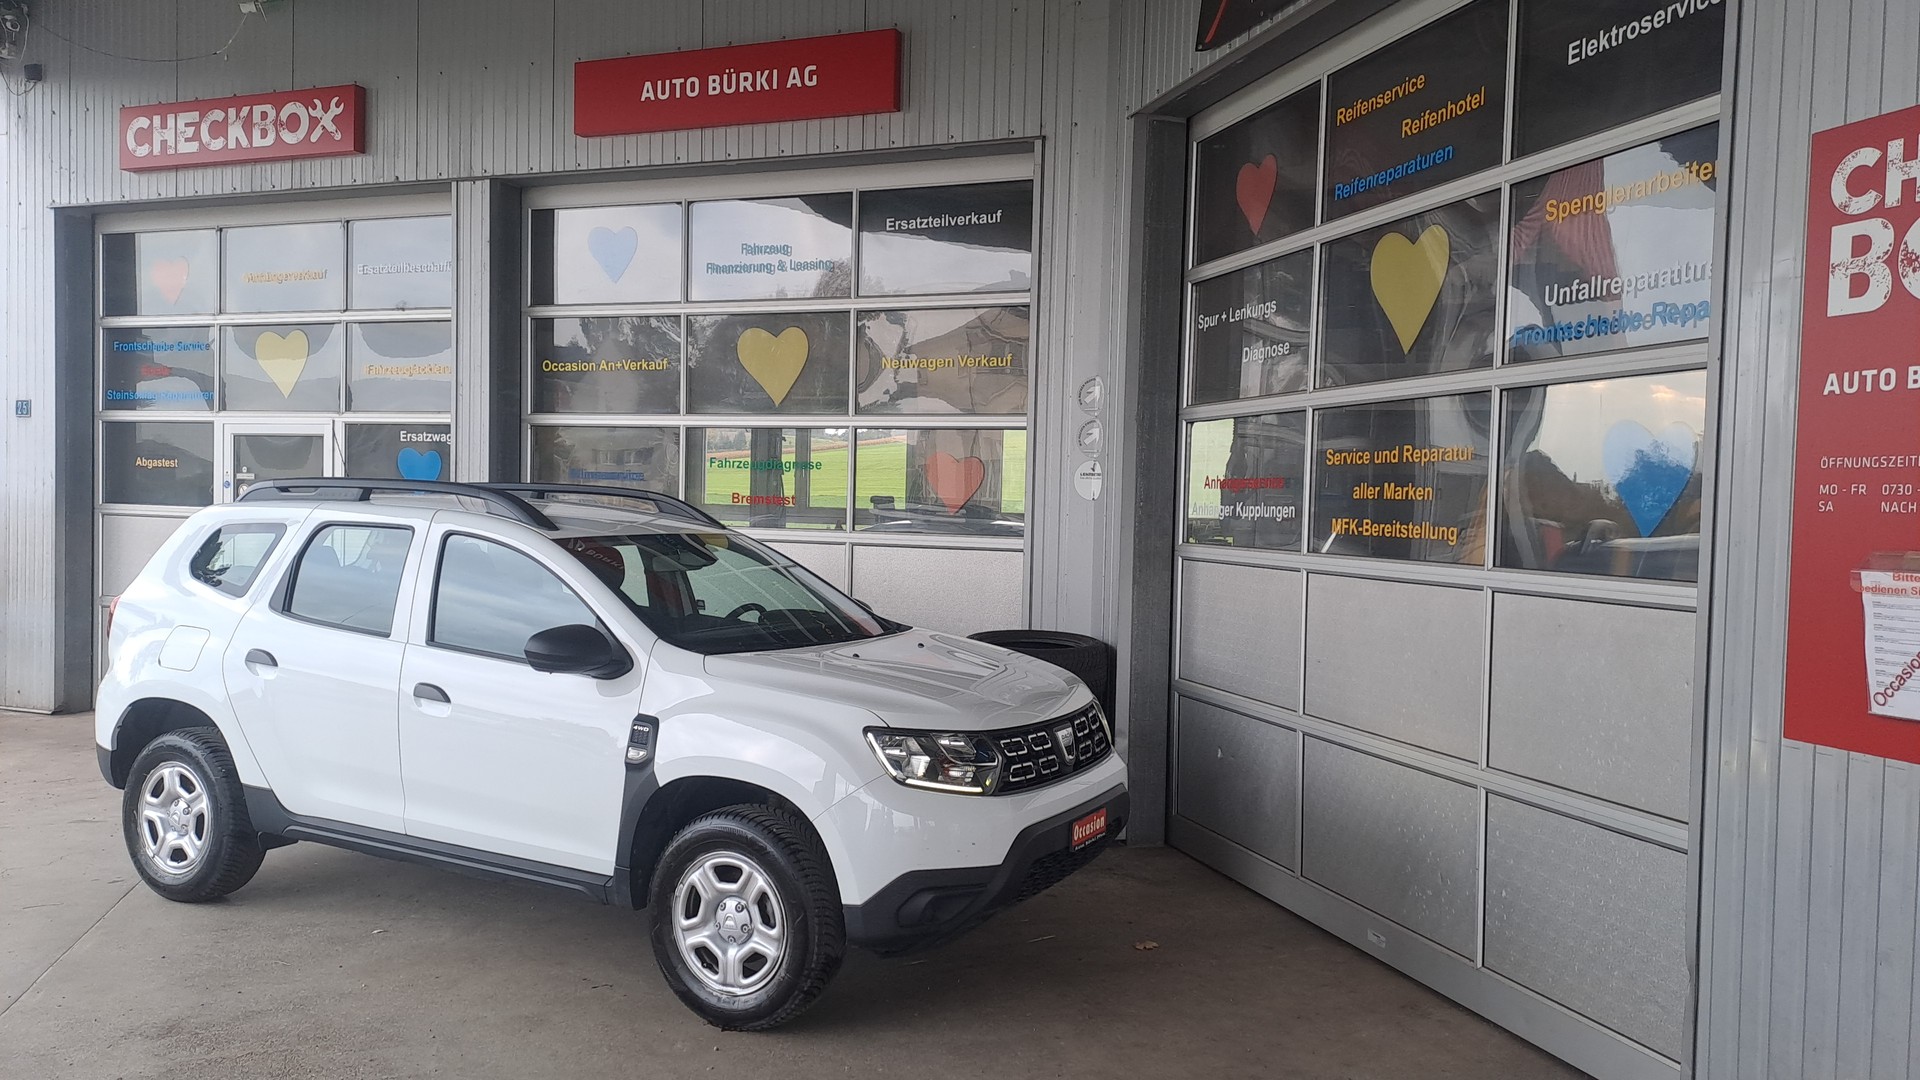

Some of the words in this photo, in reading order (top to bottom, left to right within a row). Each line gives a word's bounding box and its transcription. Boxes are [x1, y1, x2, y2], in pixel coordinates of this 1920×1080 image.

[640, 77, 700, 102] AUTO
[708, 68, 778, 96] BÜRKI
[786, 64, 818, 88] AG
[1336, 73, 1426, 127] Reifenservice
[1401, 85, 1486, 138] Reifenhotel
[1334, 143, 1454, 201] Reifenreparaturen
[1545, 160, 1719, 224] Spenglerarbeite
[885, 209, 1003, 232] Ersatzteilverkauf
[1198, 313, 1220, 332] Spur
[1221, 311, 1228, 322] +
[1229, 298, 1277, 323] Lenkungs
[881, 357, 954, 371] Neuwagen
[958, 353, 1013, 367] Verkauf
[1242, 340, 1290, 363] Diagnose
[542, 359, 596, 372] Occasion
[599, 358, 668, 372] An+Verkauf
[1822, 366, 1896, 395] AUTO
[17, 401, 28, 415] 25
[135, 456, 178, 469] Abgastest
[709, 457, 822, 472] Fahrzeugdiagnose
[1326, 448, 1371, 466] Service
[1374, 447, 1399, 465] und
[1403, 444, 1476, 470] Reparatur
[731, 492, 796, 505] Bremstest
[1352, 483, 1380, 500] aller
[1383, 482, 1433, 501] Marken
[1819, 484, 1838, 495] MO
[1850, 484, 1867, 495] FR
[1881, 484, 1912, 495] 0730
[1191, 501, 1234, 520] Anhänger
[1235, 501, 1296, 522] Kupplungen
[1818, 501, 1834, 512] SA
[1881, 501, 1917, 513] NACH
[1331, 518, 1458, 546] MFK-Bereitstellung
[632, 724, 650, 732] 4WD
[1073, 815, 1106, 842] Occasion
